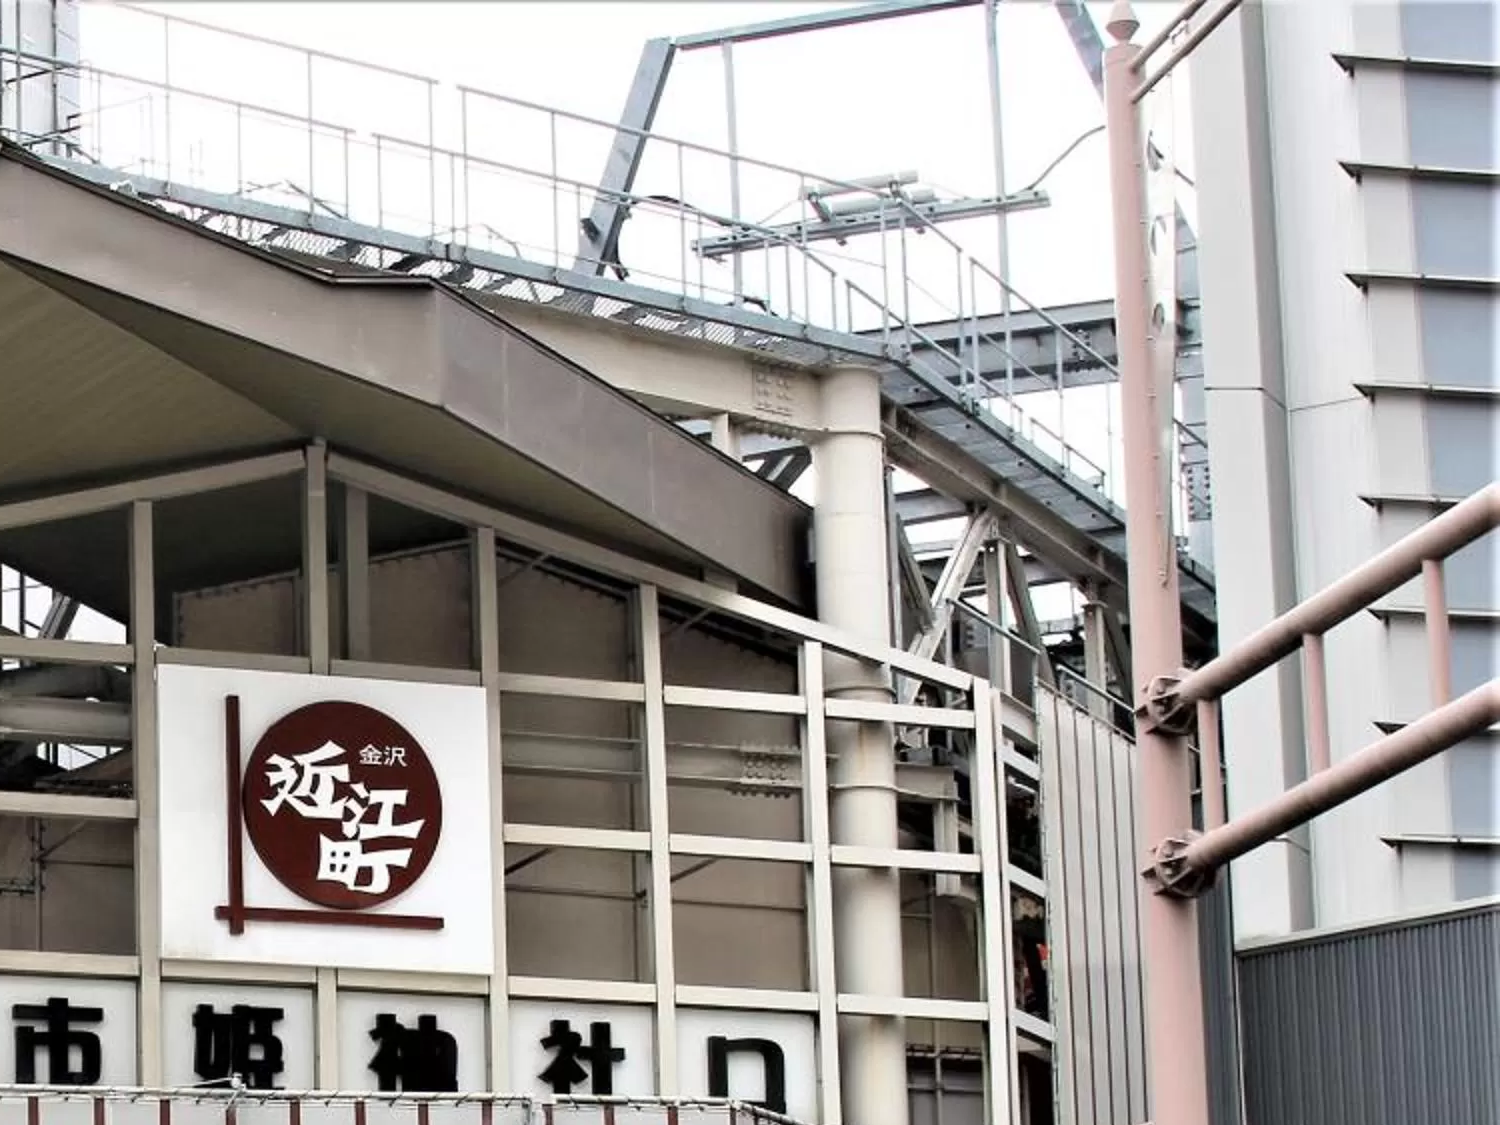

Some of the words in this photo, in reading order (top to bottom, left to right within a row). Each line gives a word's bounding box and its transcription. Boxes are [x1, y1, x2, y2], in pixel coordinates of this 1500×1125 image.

[359, 743, 408, 767] 金沢
[259, 740, 426, 894] 近江町
